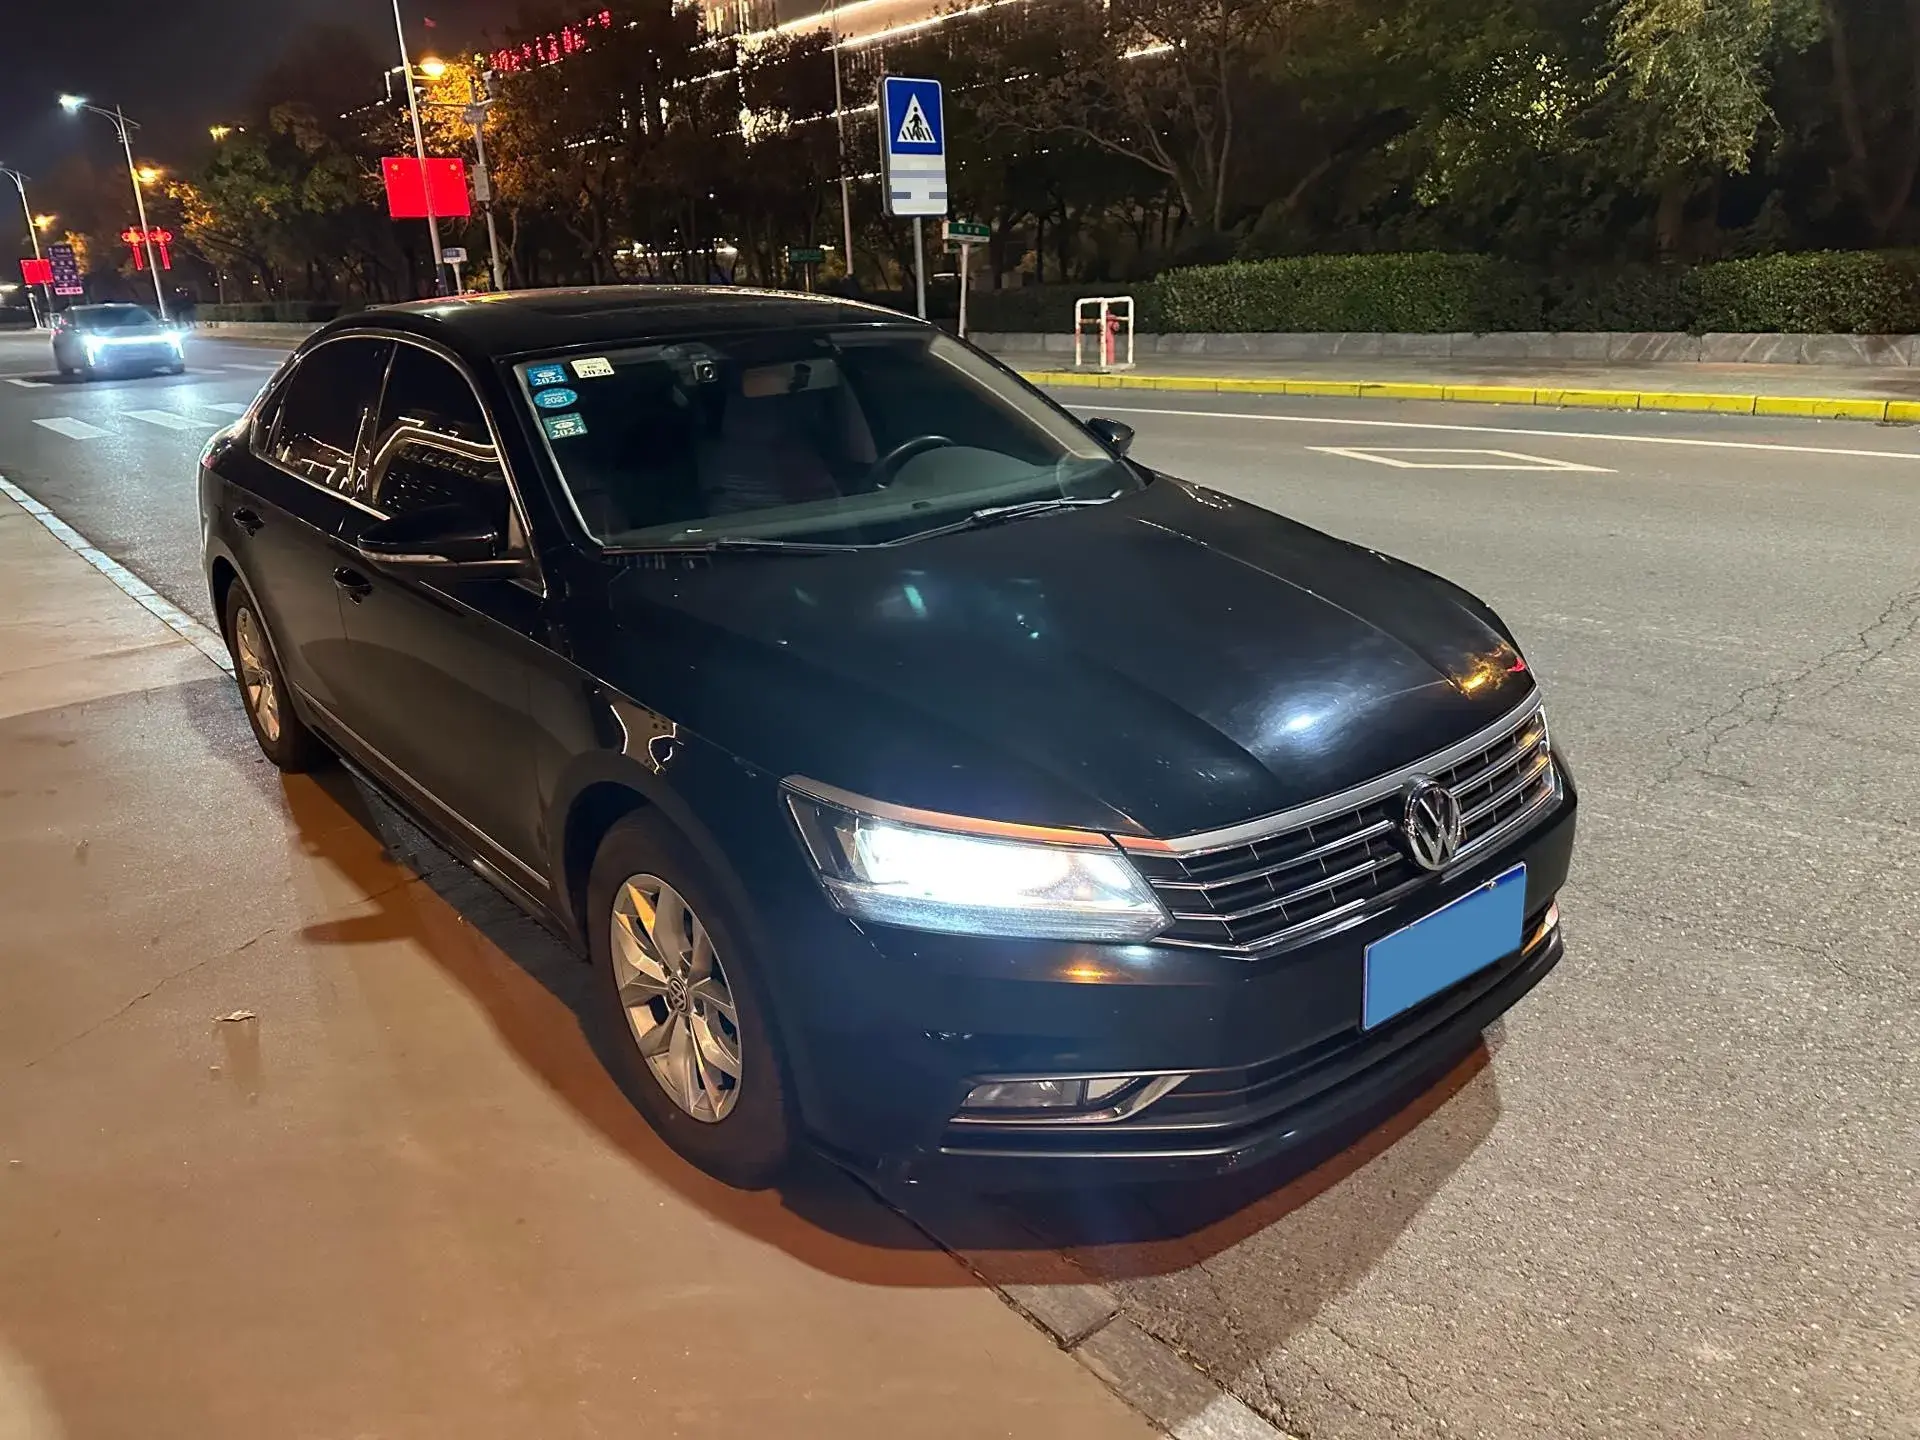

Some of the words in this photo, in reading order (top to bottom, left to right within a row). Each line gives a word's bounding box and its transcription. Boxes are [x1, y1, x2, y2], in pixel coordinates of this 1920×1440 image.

[582, 369, 611, 377] 2026
[535, 375, 564, 386] 2022
[544, 395, 568, 404] 2021
[551, 426, 585, 438] 2024
